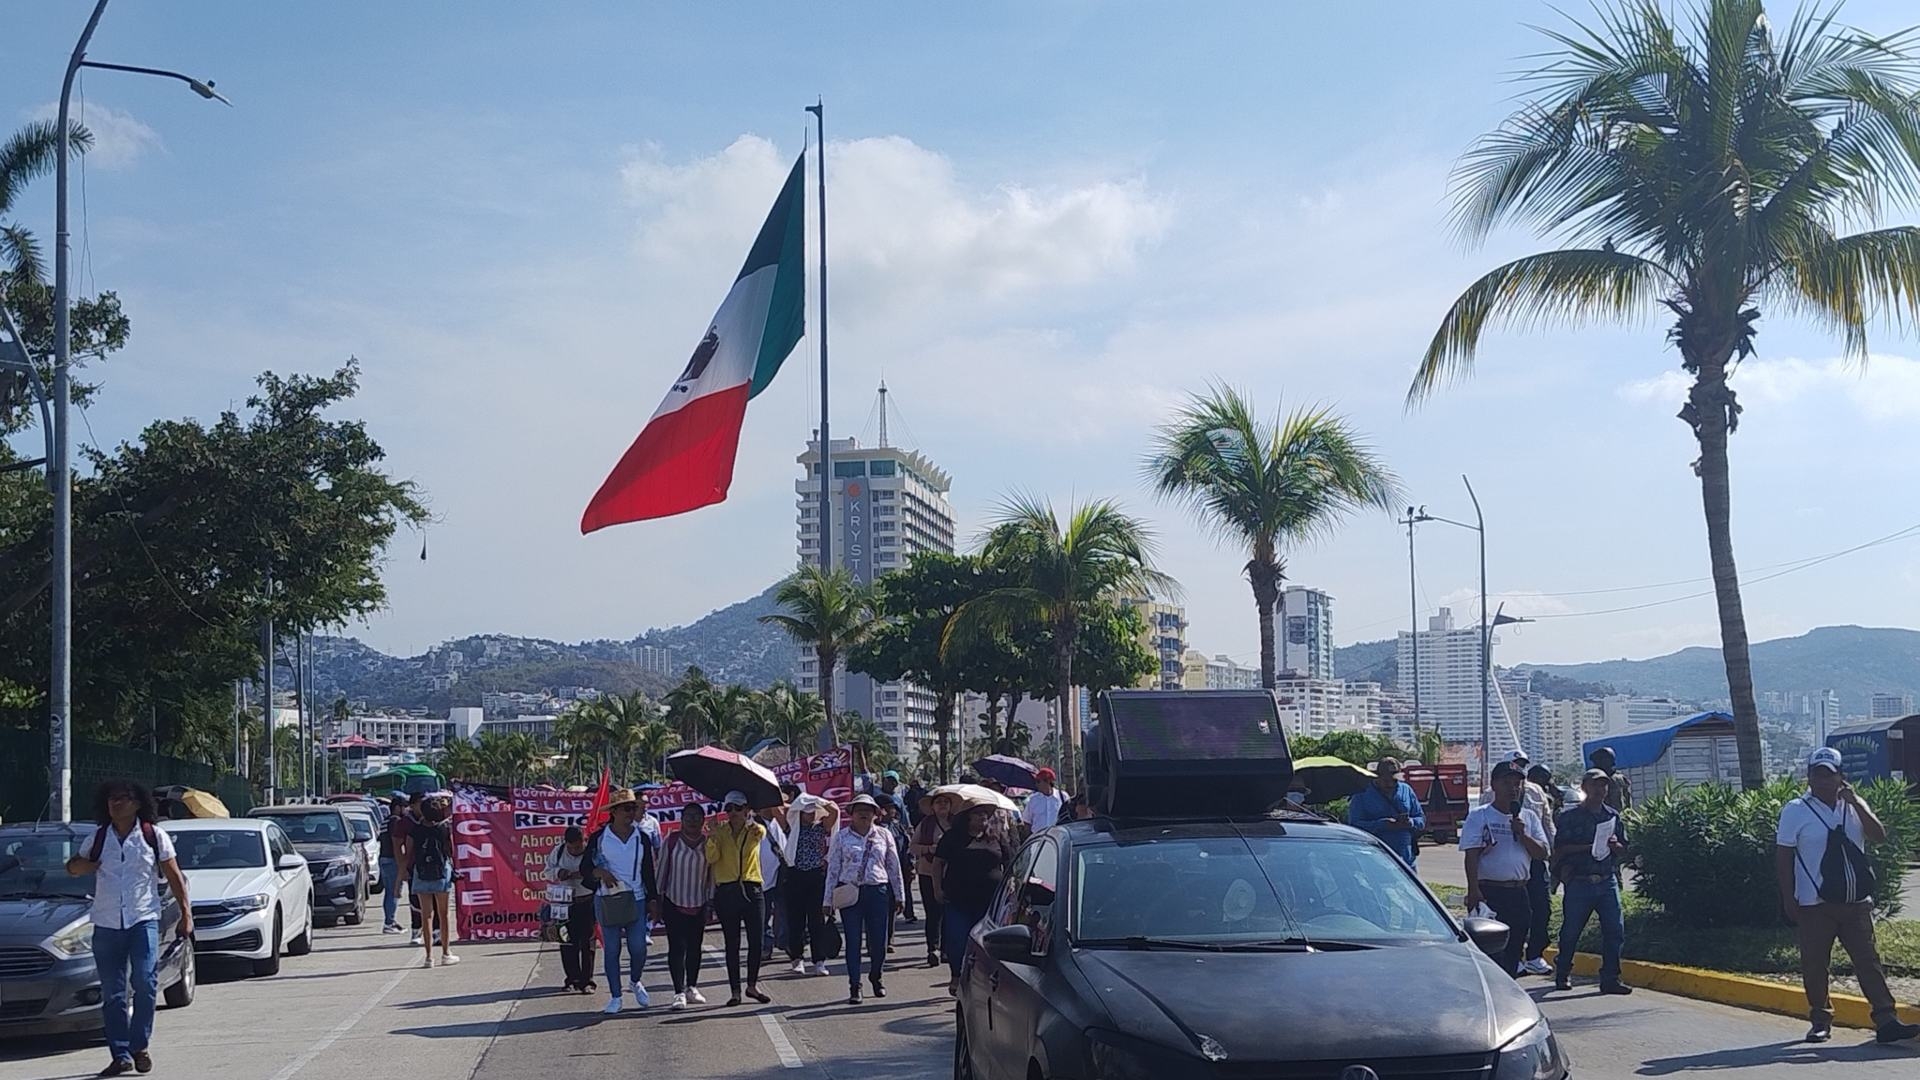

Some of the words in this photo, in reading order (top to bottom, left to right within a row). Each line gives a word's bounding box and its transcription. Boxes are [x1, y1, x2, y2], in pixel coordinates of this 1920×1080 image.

[850, 501, 862, 584] KRYSTA
[515, 799, 538, 810] DE
[543, 800, 566, 811] LA
